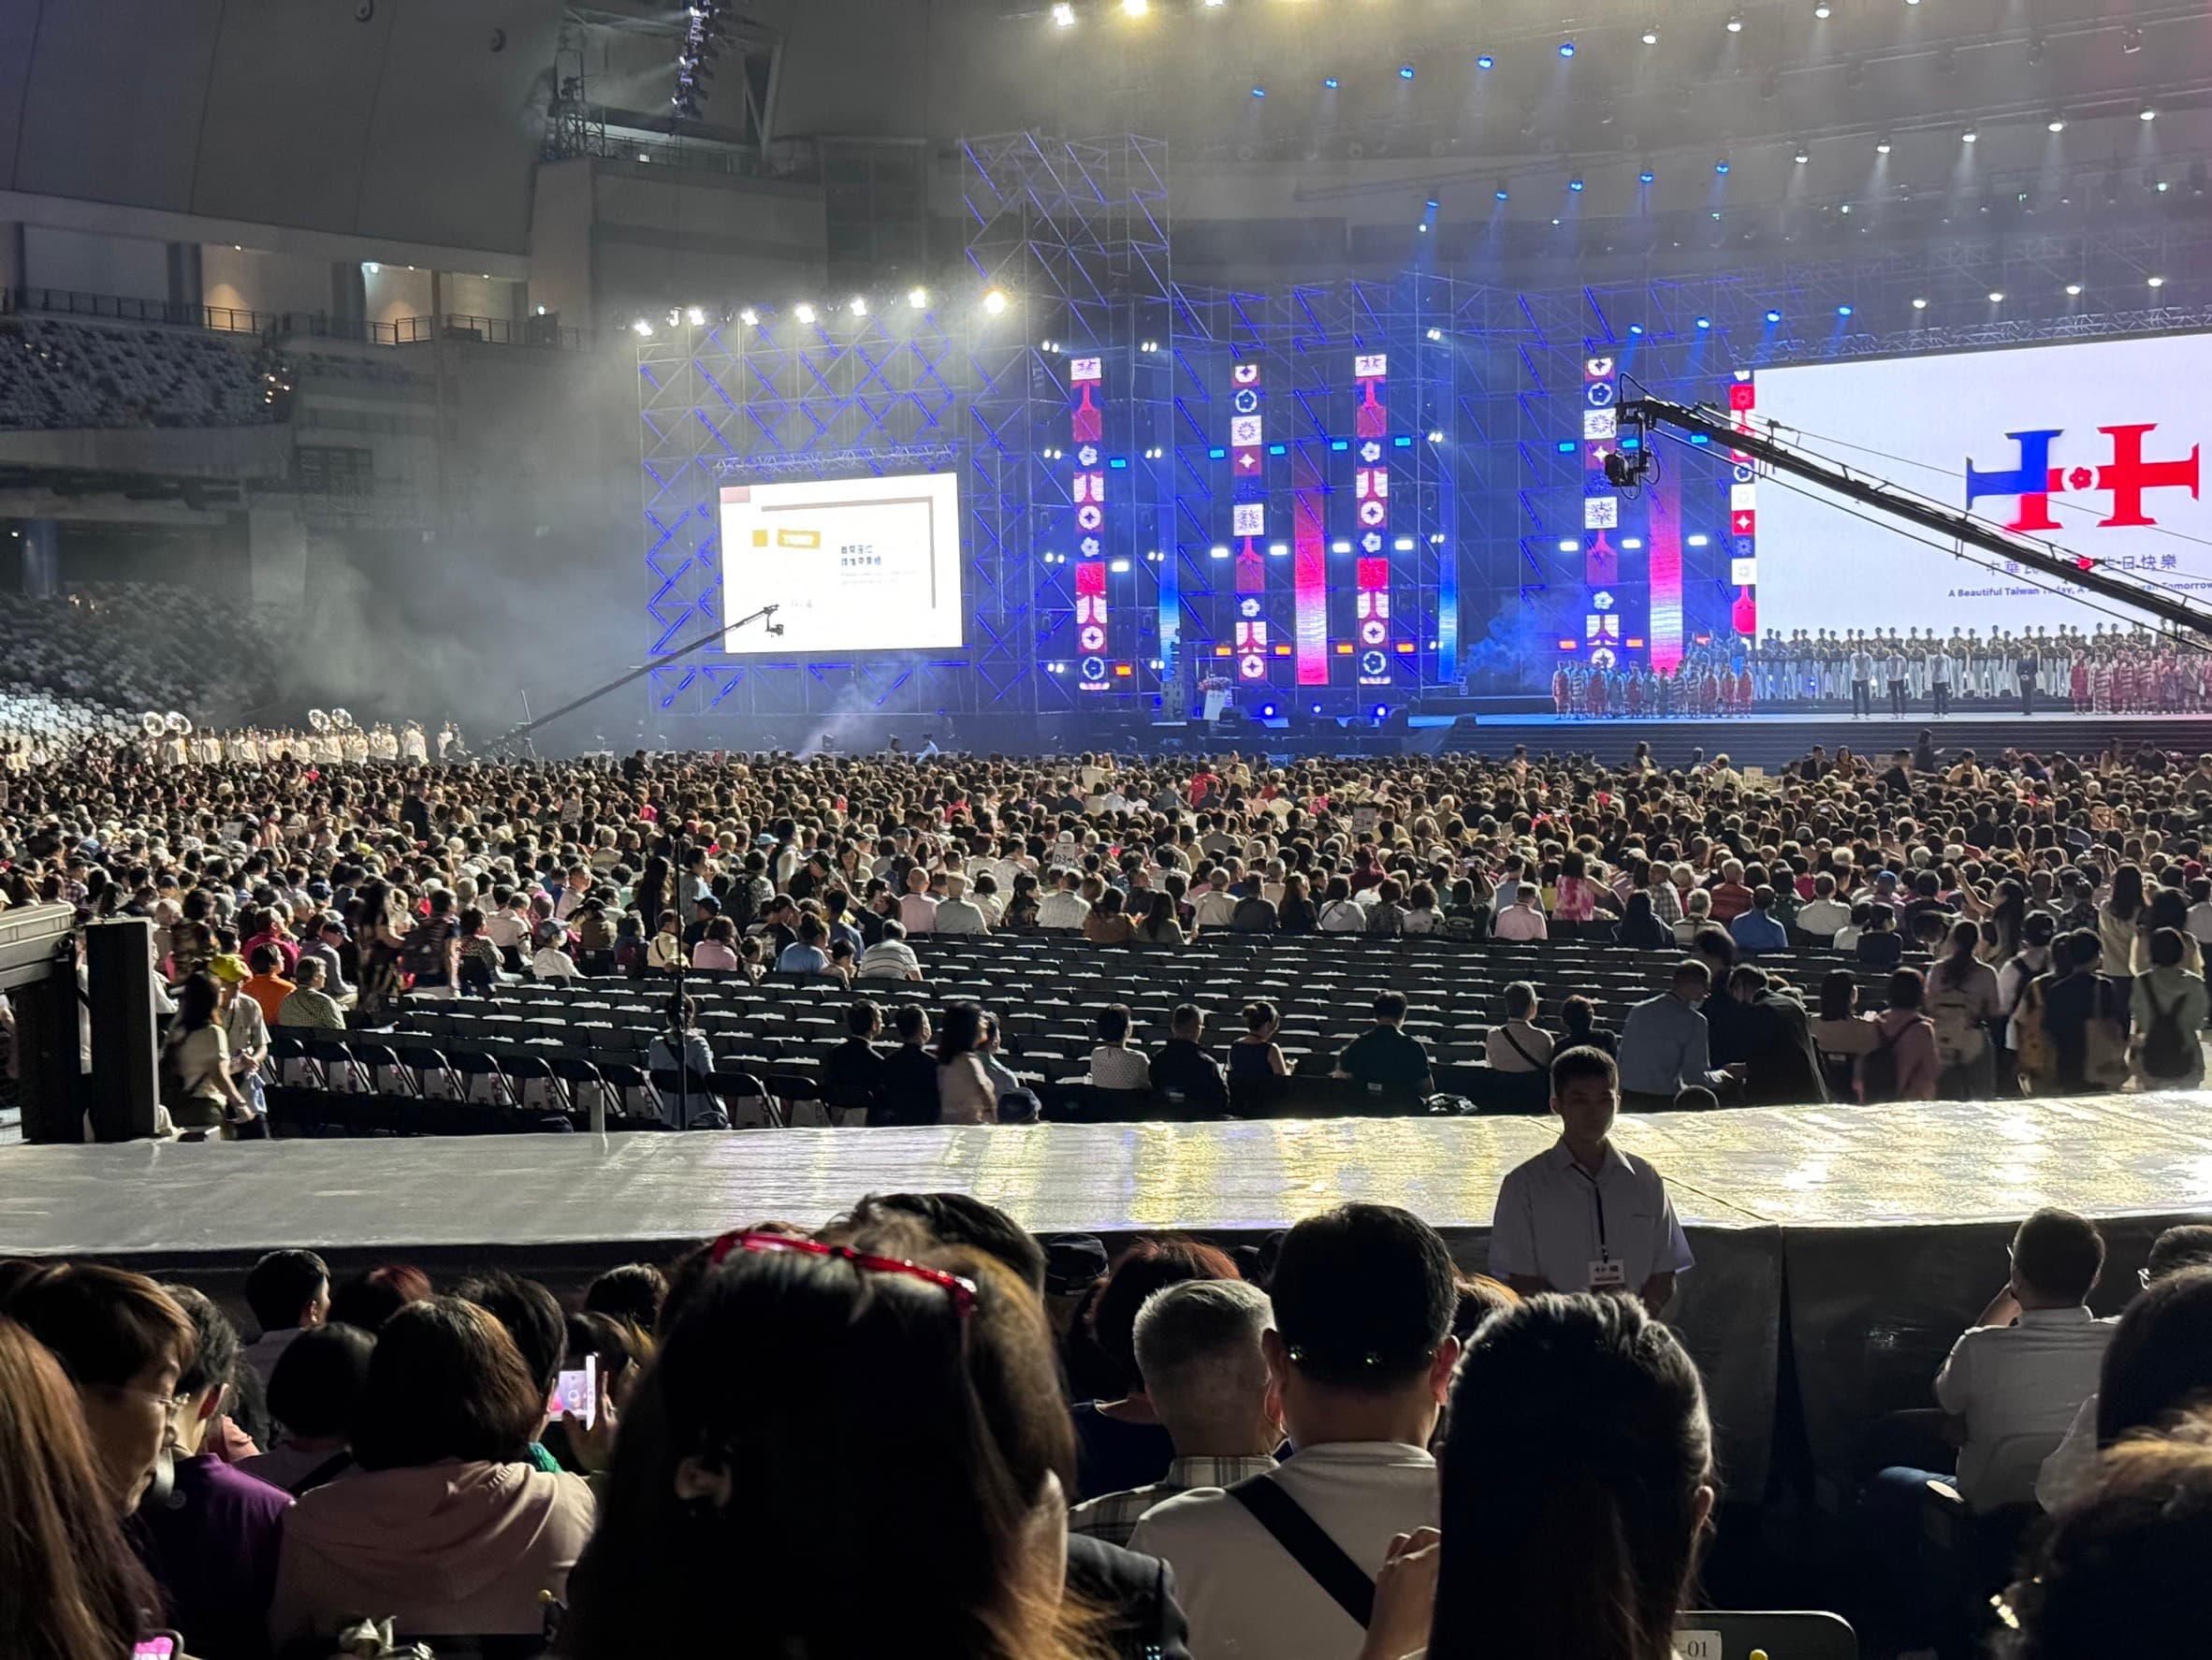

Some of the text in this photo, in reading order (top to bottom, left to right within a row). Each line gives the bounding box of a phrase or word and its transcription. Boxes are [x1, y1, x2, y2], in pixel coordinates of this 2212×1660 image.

[1948, 590, 1956, 598] A
[1957, 588, 2002, 597] Beautiful
[2004, 586, 2040, 596] Taiwan
